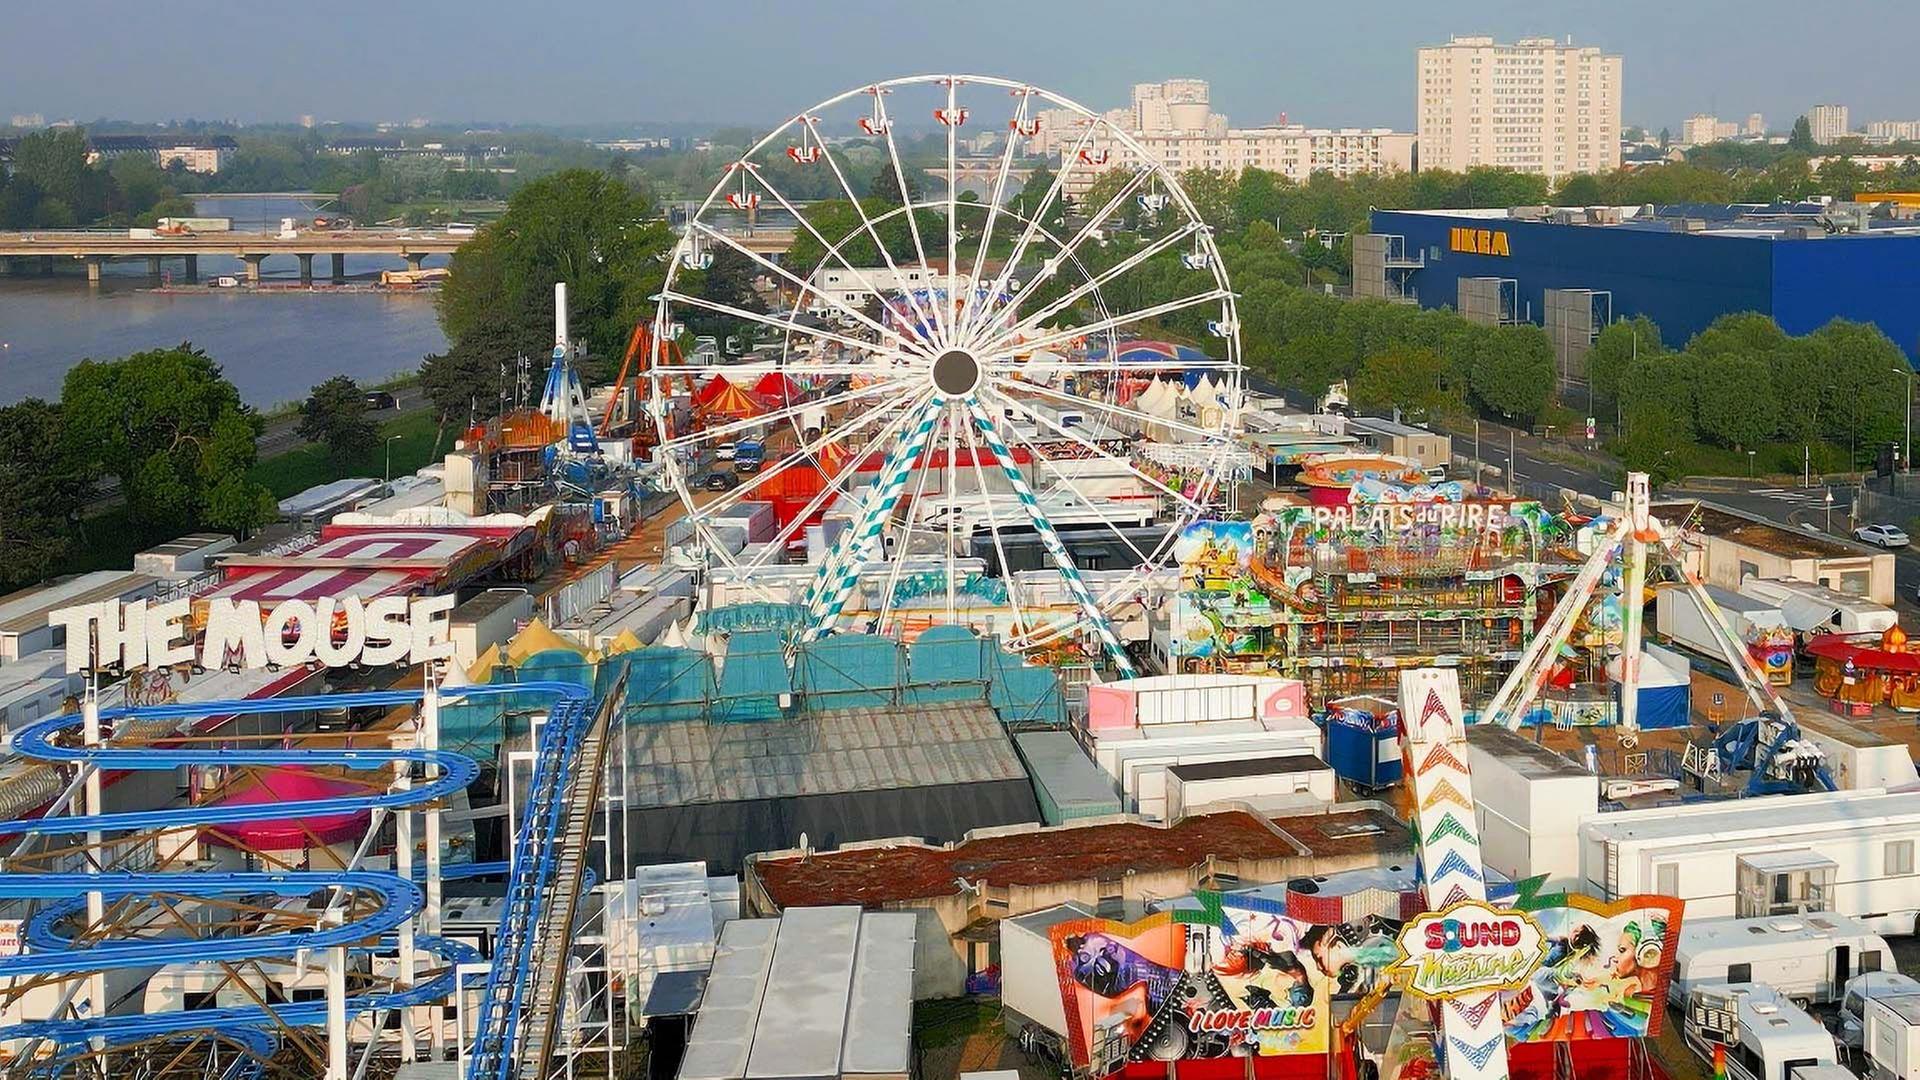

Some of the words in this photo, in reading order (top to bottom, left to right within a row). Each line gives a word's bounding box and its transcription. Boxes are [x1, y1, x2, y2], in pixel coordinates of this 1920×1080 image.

[1451, 228, 1510, 256] IKEA
[1314, 504, 1414, 531] PALAIS
[1416, 506, 1438, 523] du
[1441, 503, 1506, 530] RIRE
[48, 595, 195, 674] THE
[200, 593, 456, 671] MOUSE
[1424, 919, 1521, 952] SOUND
[1190, 1011, 1203, 1032] I
[1202, 1009, 1252, 1031] LOVE
[1252, 1007, 1316, 1029] MUSIC
